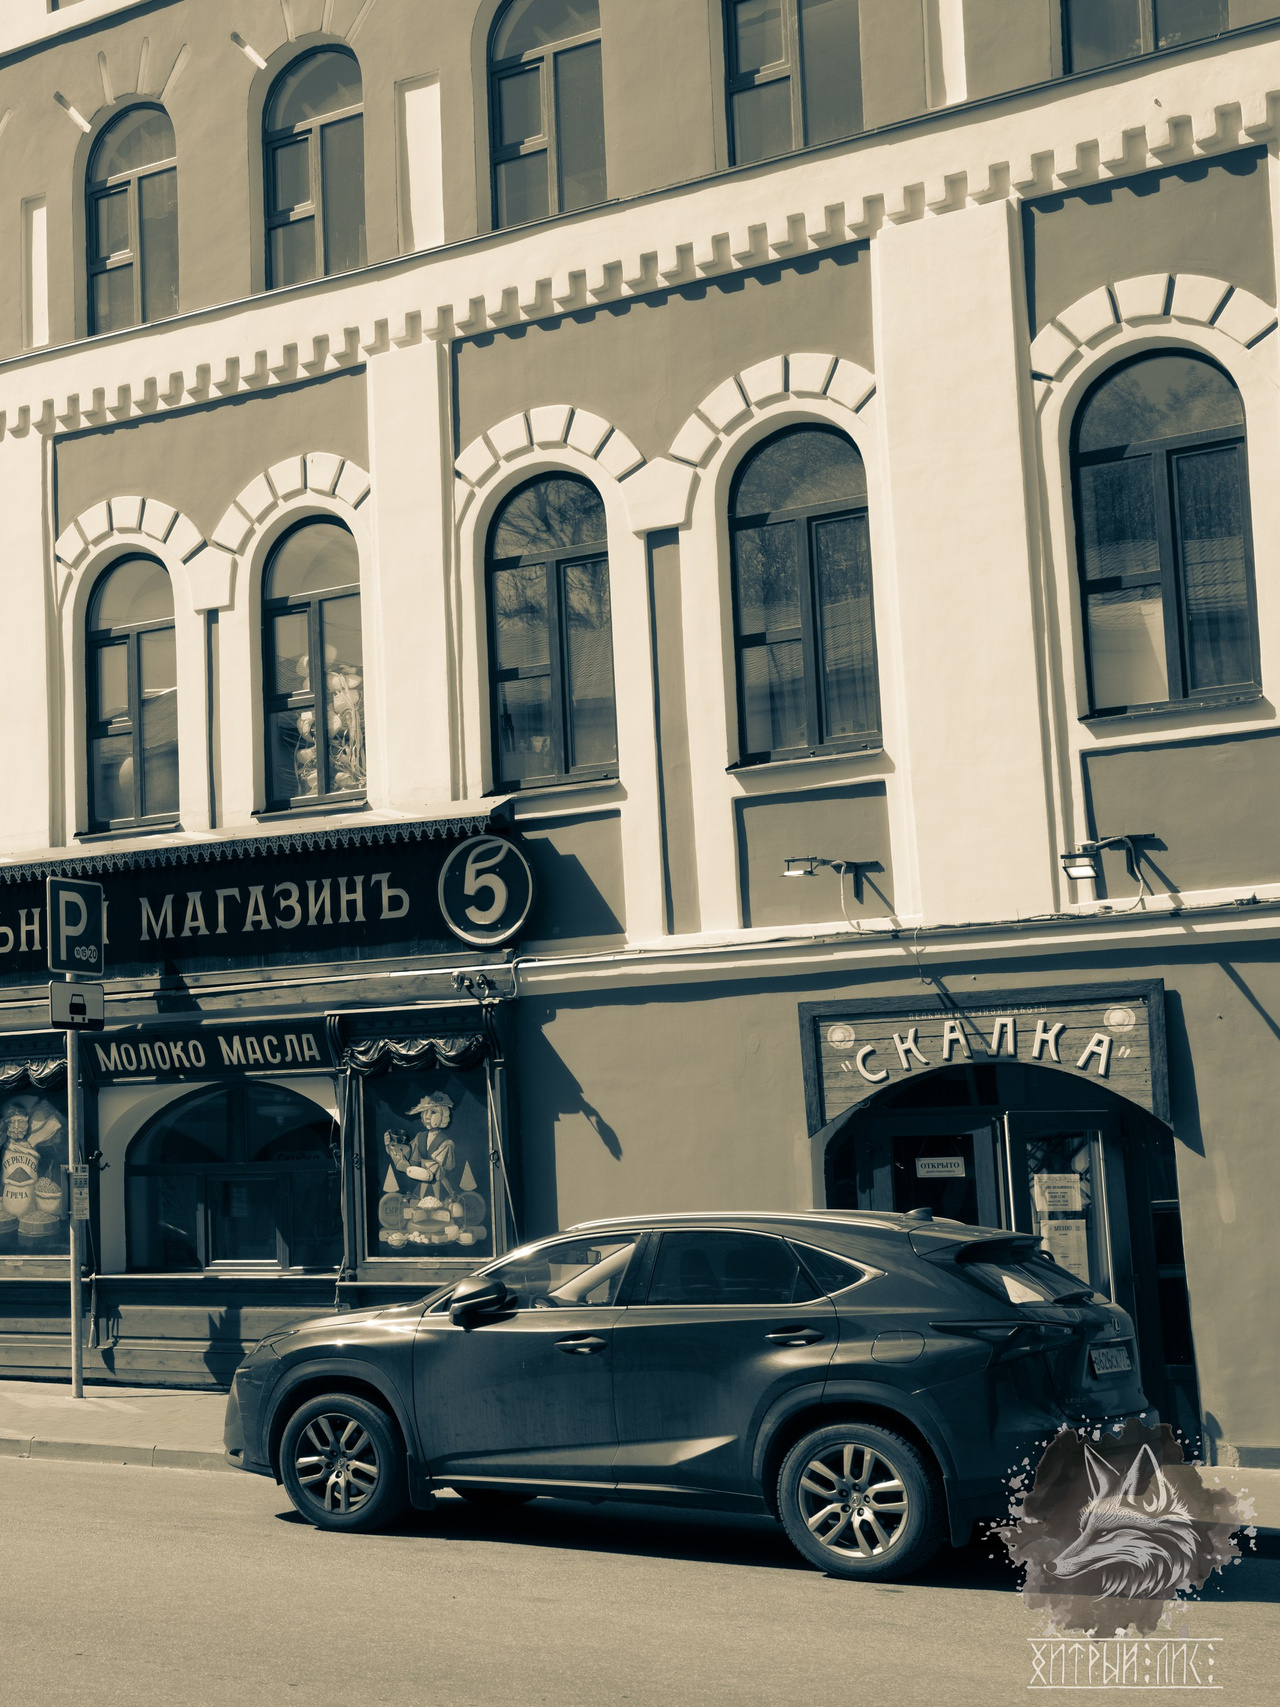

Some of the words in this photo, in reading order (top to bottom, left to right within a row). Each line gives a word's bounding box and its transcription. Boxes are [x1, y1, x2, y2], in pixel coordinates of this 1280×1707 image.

[139, 872, 411, 941] МАГАЗИНЪ
[59, 890, 88, 961] P
[89, 946, 98, 961] 20
[908, 1010, 963, 1021] ПЕЛЬМЕНИ
[1007, 1004, 1048, 1015] РАБОТЫ
[94, 1038, 206, 1072] МОЛОКО
[217, 1033, 321, 1066] МАСЛА
[920, 1161, 960, 1170] ОТКРЫТО
